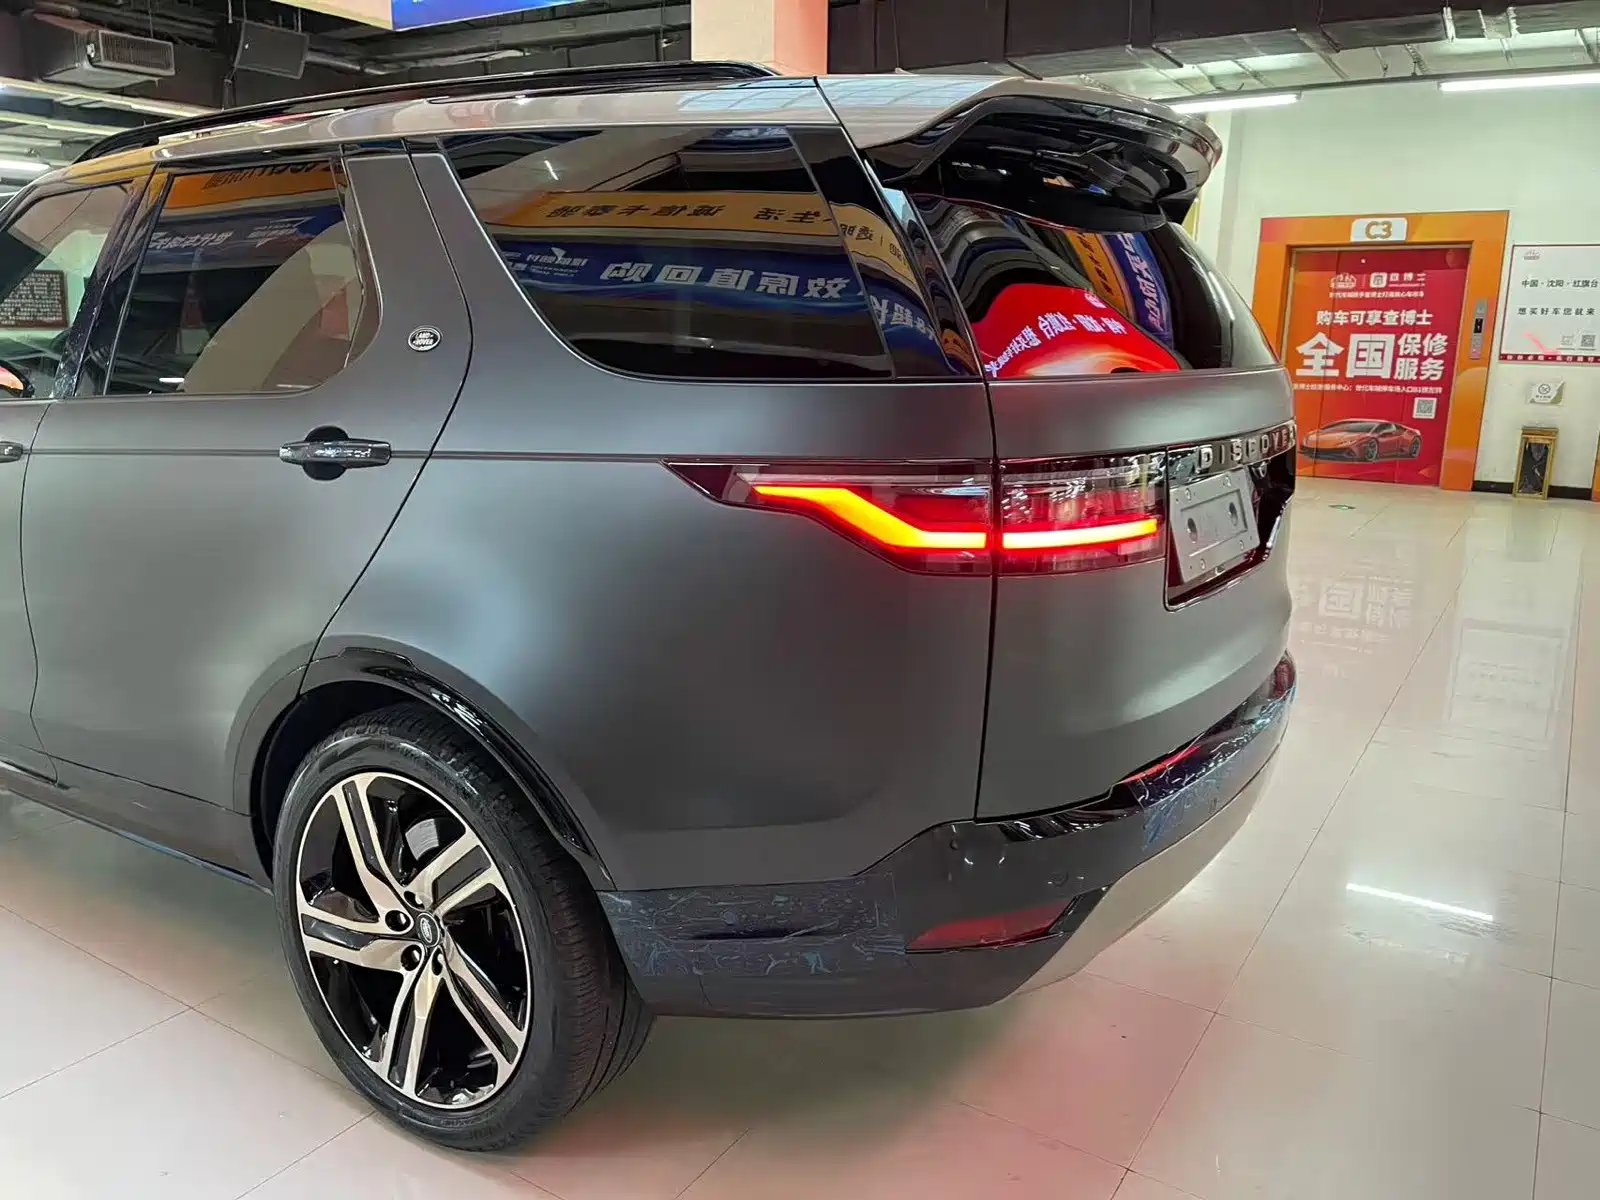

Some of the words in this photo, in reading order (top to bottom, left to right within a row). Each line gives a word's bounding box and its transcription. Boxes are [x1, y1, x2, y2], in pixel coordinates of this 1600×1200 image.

[1364, 220, 1393, 240] C3
[1315, 309, 1434, 326] 购车可享查博士
[1295, 331, 1396, 379] 全国
[1396, 332, 1449, 357] 保修
[1393, 357, 1446, 381] 服务
